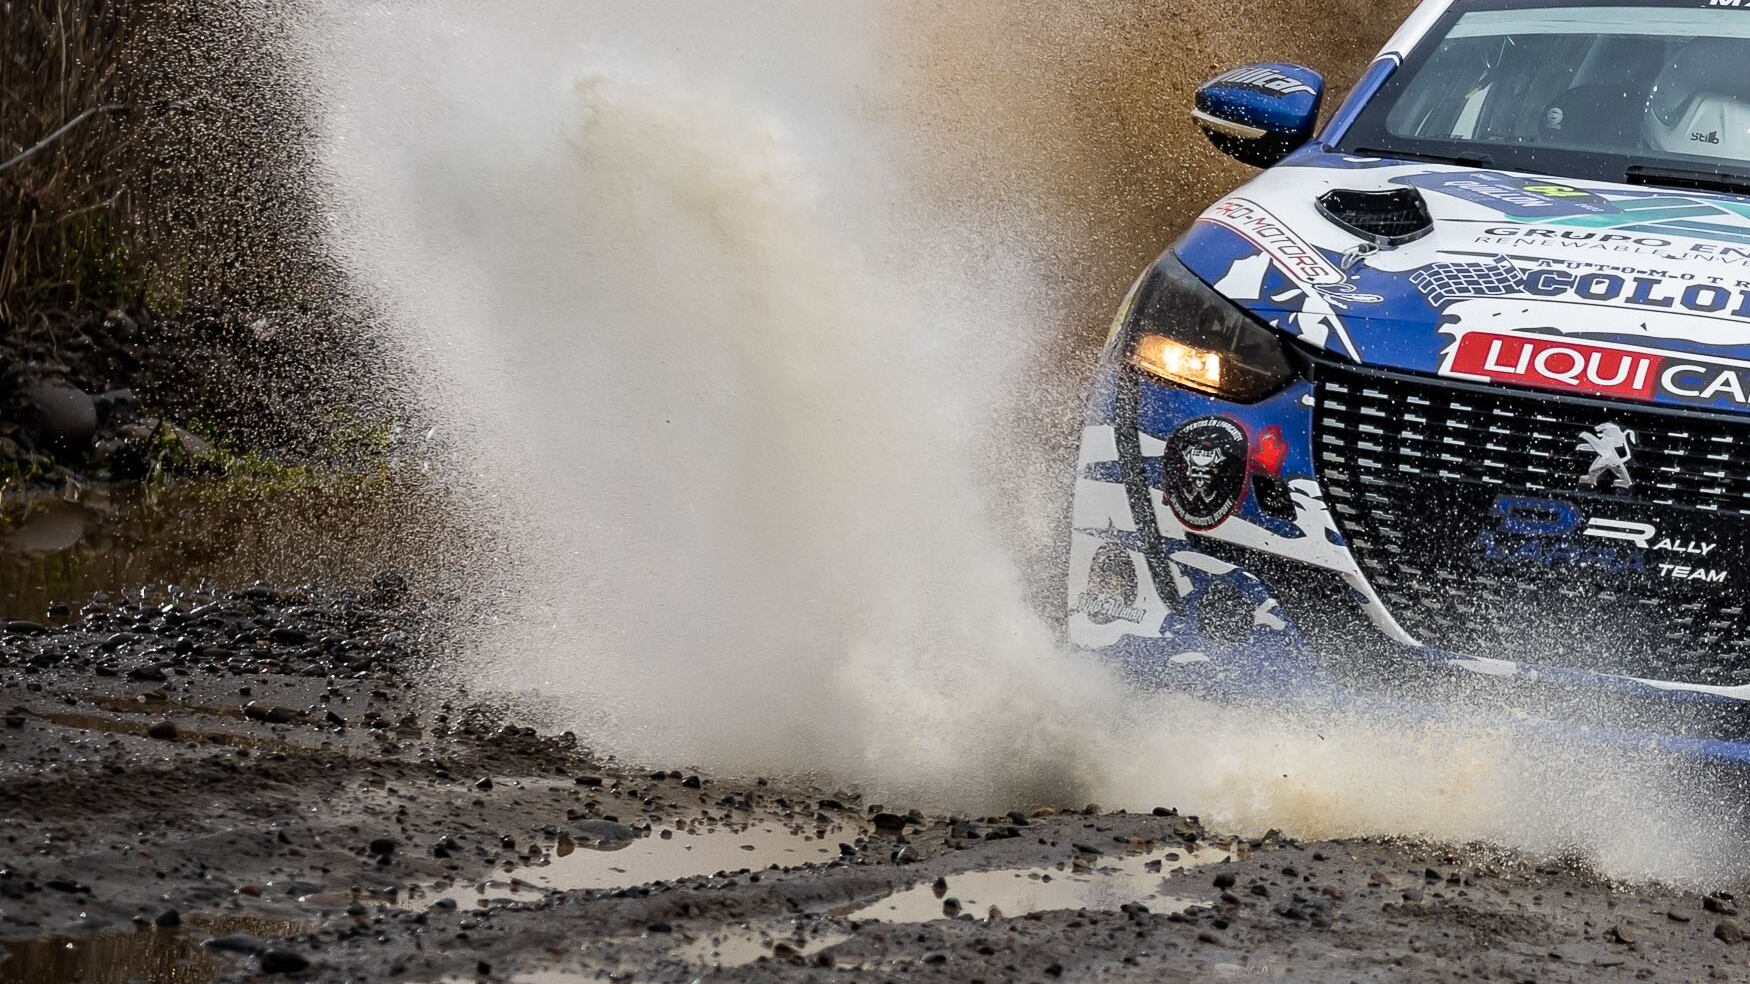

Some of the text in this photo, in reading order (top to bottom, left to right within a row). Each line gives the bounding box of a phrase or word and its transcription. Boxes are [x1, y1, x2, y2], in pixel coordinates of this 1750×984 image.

[1474, 236, 1668, 259] RENEWABLE
[1483, 226, 1672, 248] GRUPO
[1483, 338, 1651, 391] LIQUI
[1583, 517, 1716, 556] RALLY
[1658, 563, 1728, 583] TEAM
